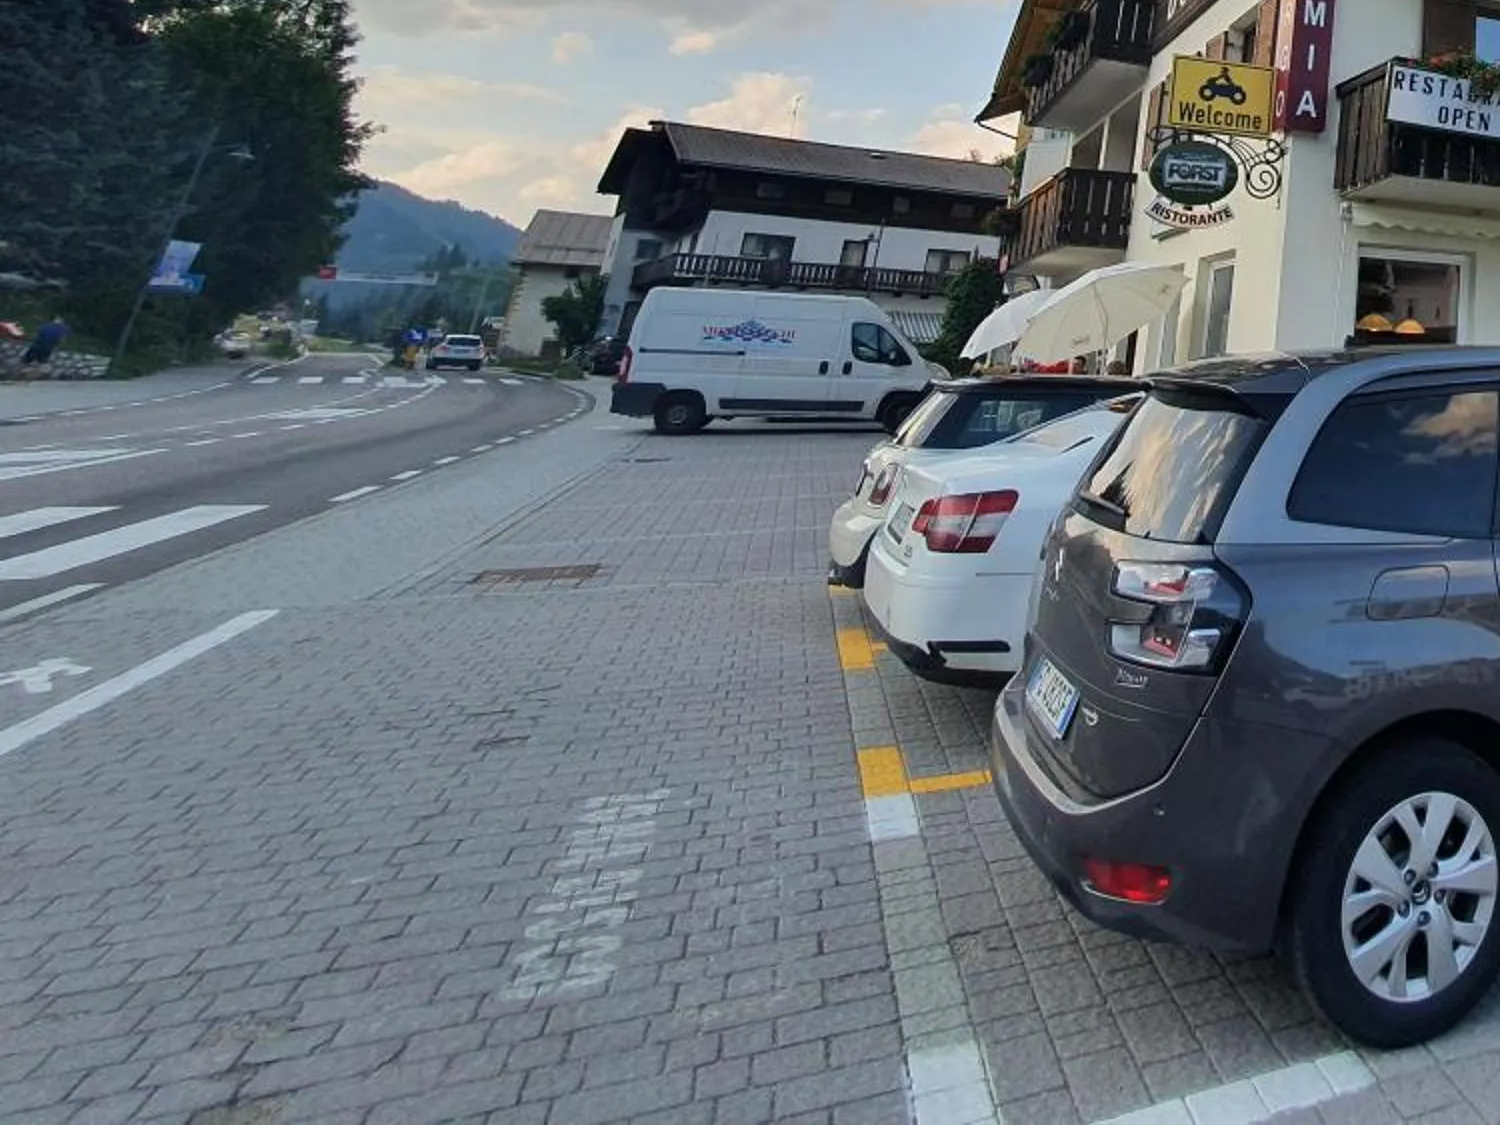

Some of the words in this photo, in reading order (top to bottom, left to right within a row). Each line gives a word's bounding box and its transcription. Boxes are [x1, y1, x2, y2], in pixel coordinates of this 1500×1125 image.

[1180, 101, 1262, 130] Welcome
[1438, 105, 1491, 131] OPEN
[1168, 162, 1223, 181] FORST
[1150, 202, 1234, 226] RISTORANTE
